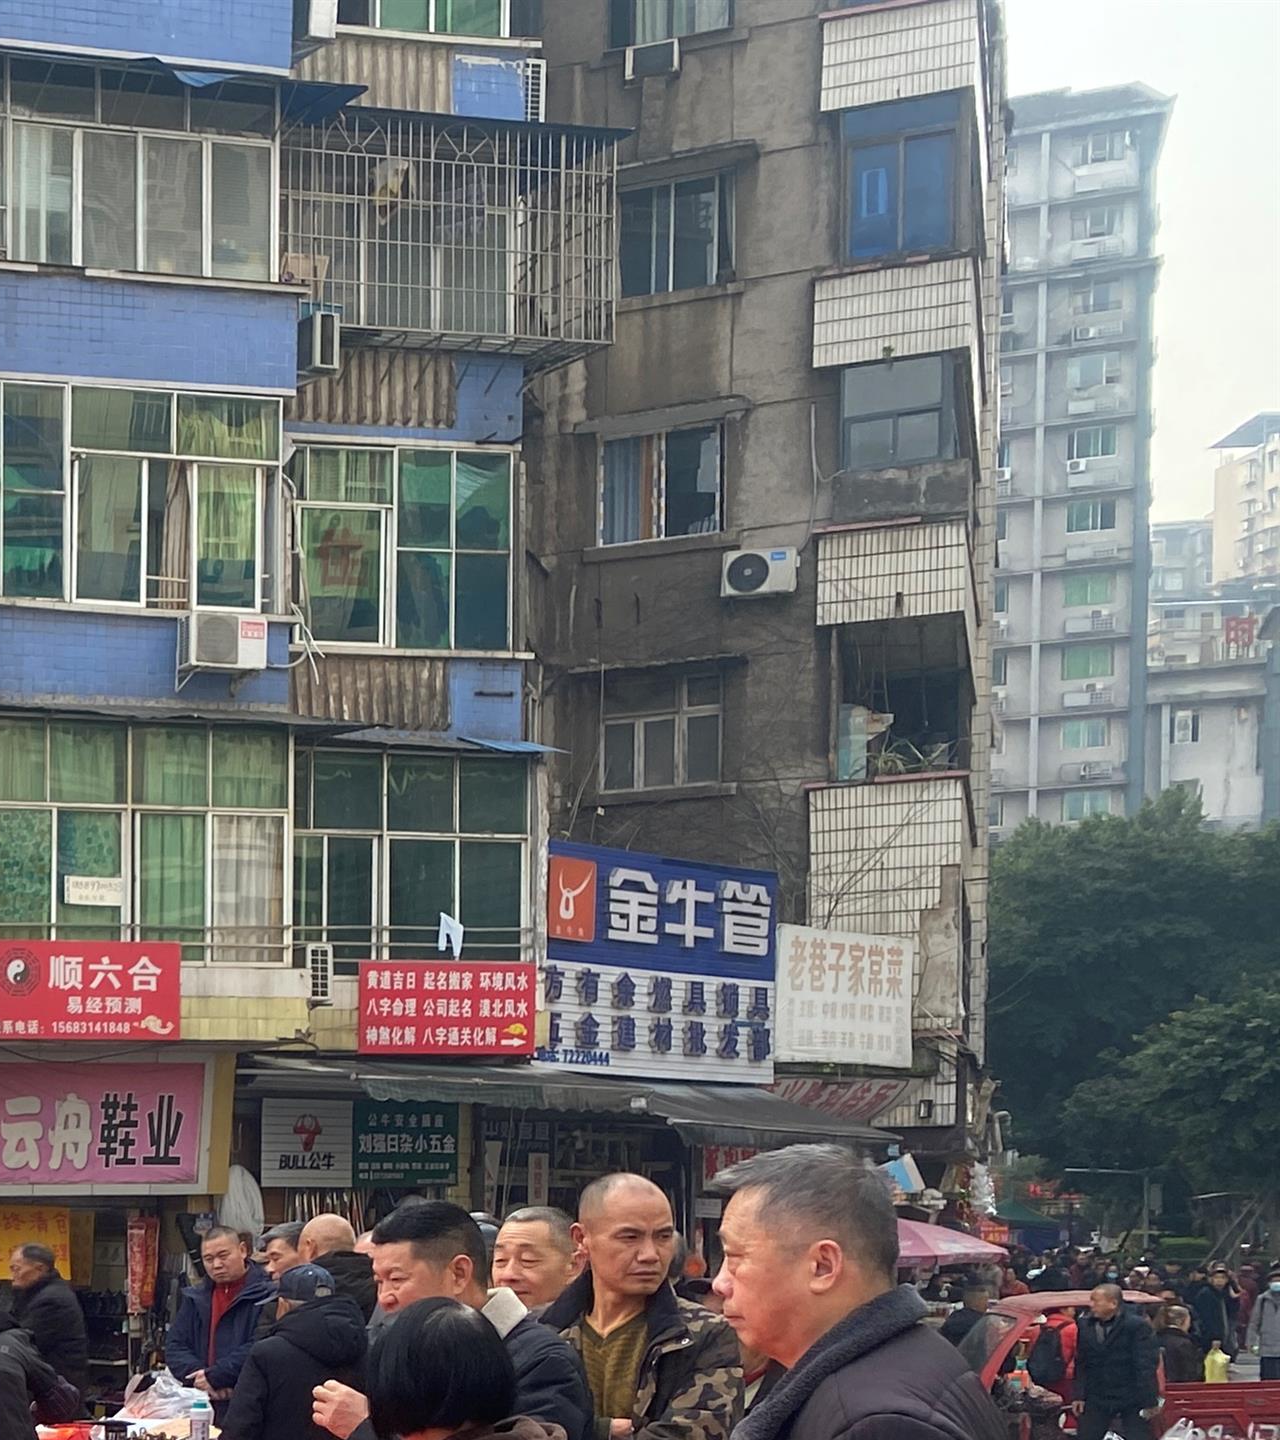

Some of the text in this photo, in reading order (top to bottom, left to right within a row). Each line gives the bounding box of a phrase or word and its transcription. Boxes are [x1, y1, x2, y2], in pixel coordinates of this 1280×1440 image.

[606, 867, 772, 957] 金牛管
[48, 955, 162, 992] 顺六合
[367, 970, 529, 991] 黄道吉日 起名搬家 环境风水
[787, 933, 904, 1000] 老巷子家常菜
[66, 996, 142, 1014] 易经预测
[366, 997, 417, 1017] 八字命理
[423, 998, 472, 1018] 公司起名
[97, 1092, 184, 1168] 鞋业
